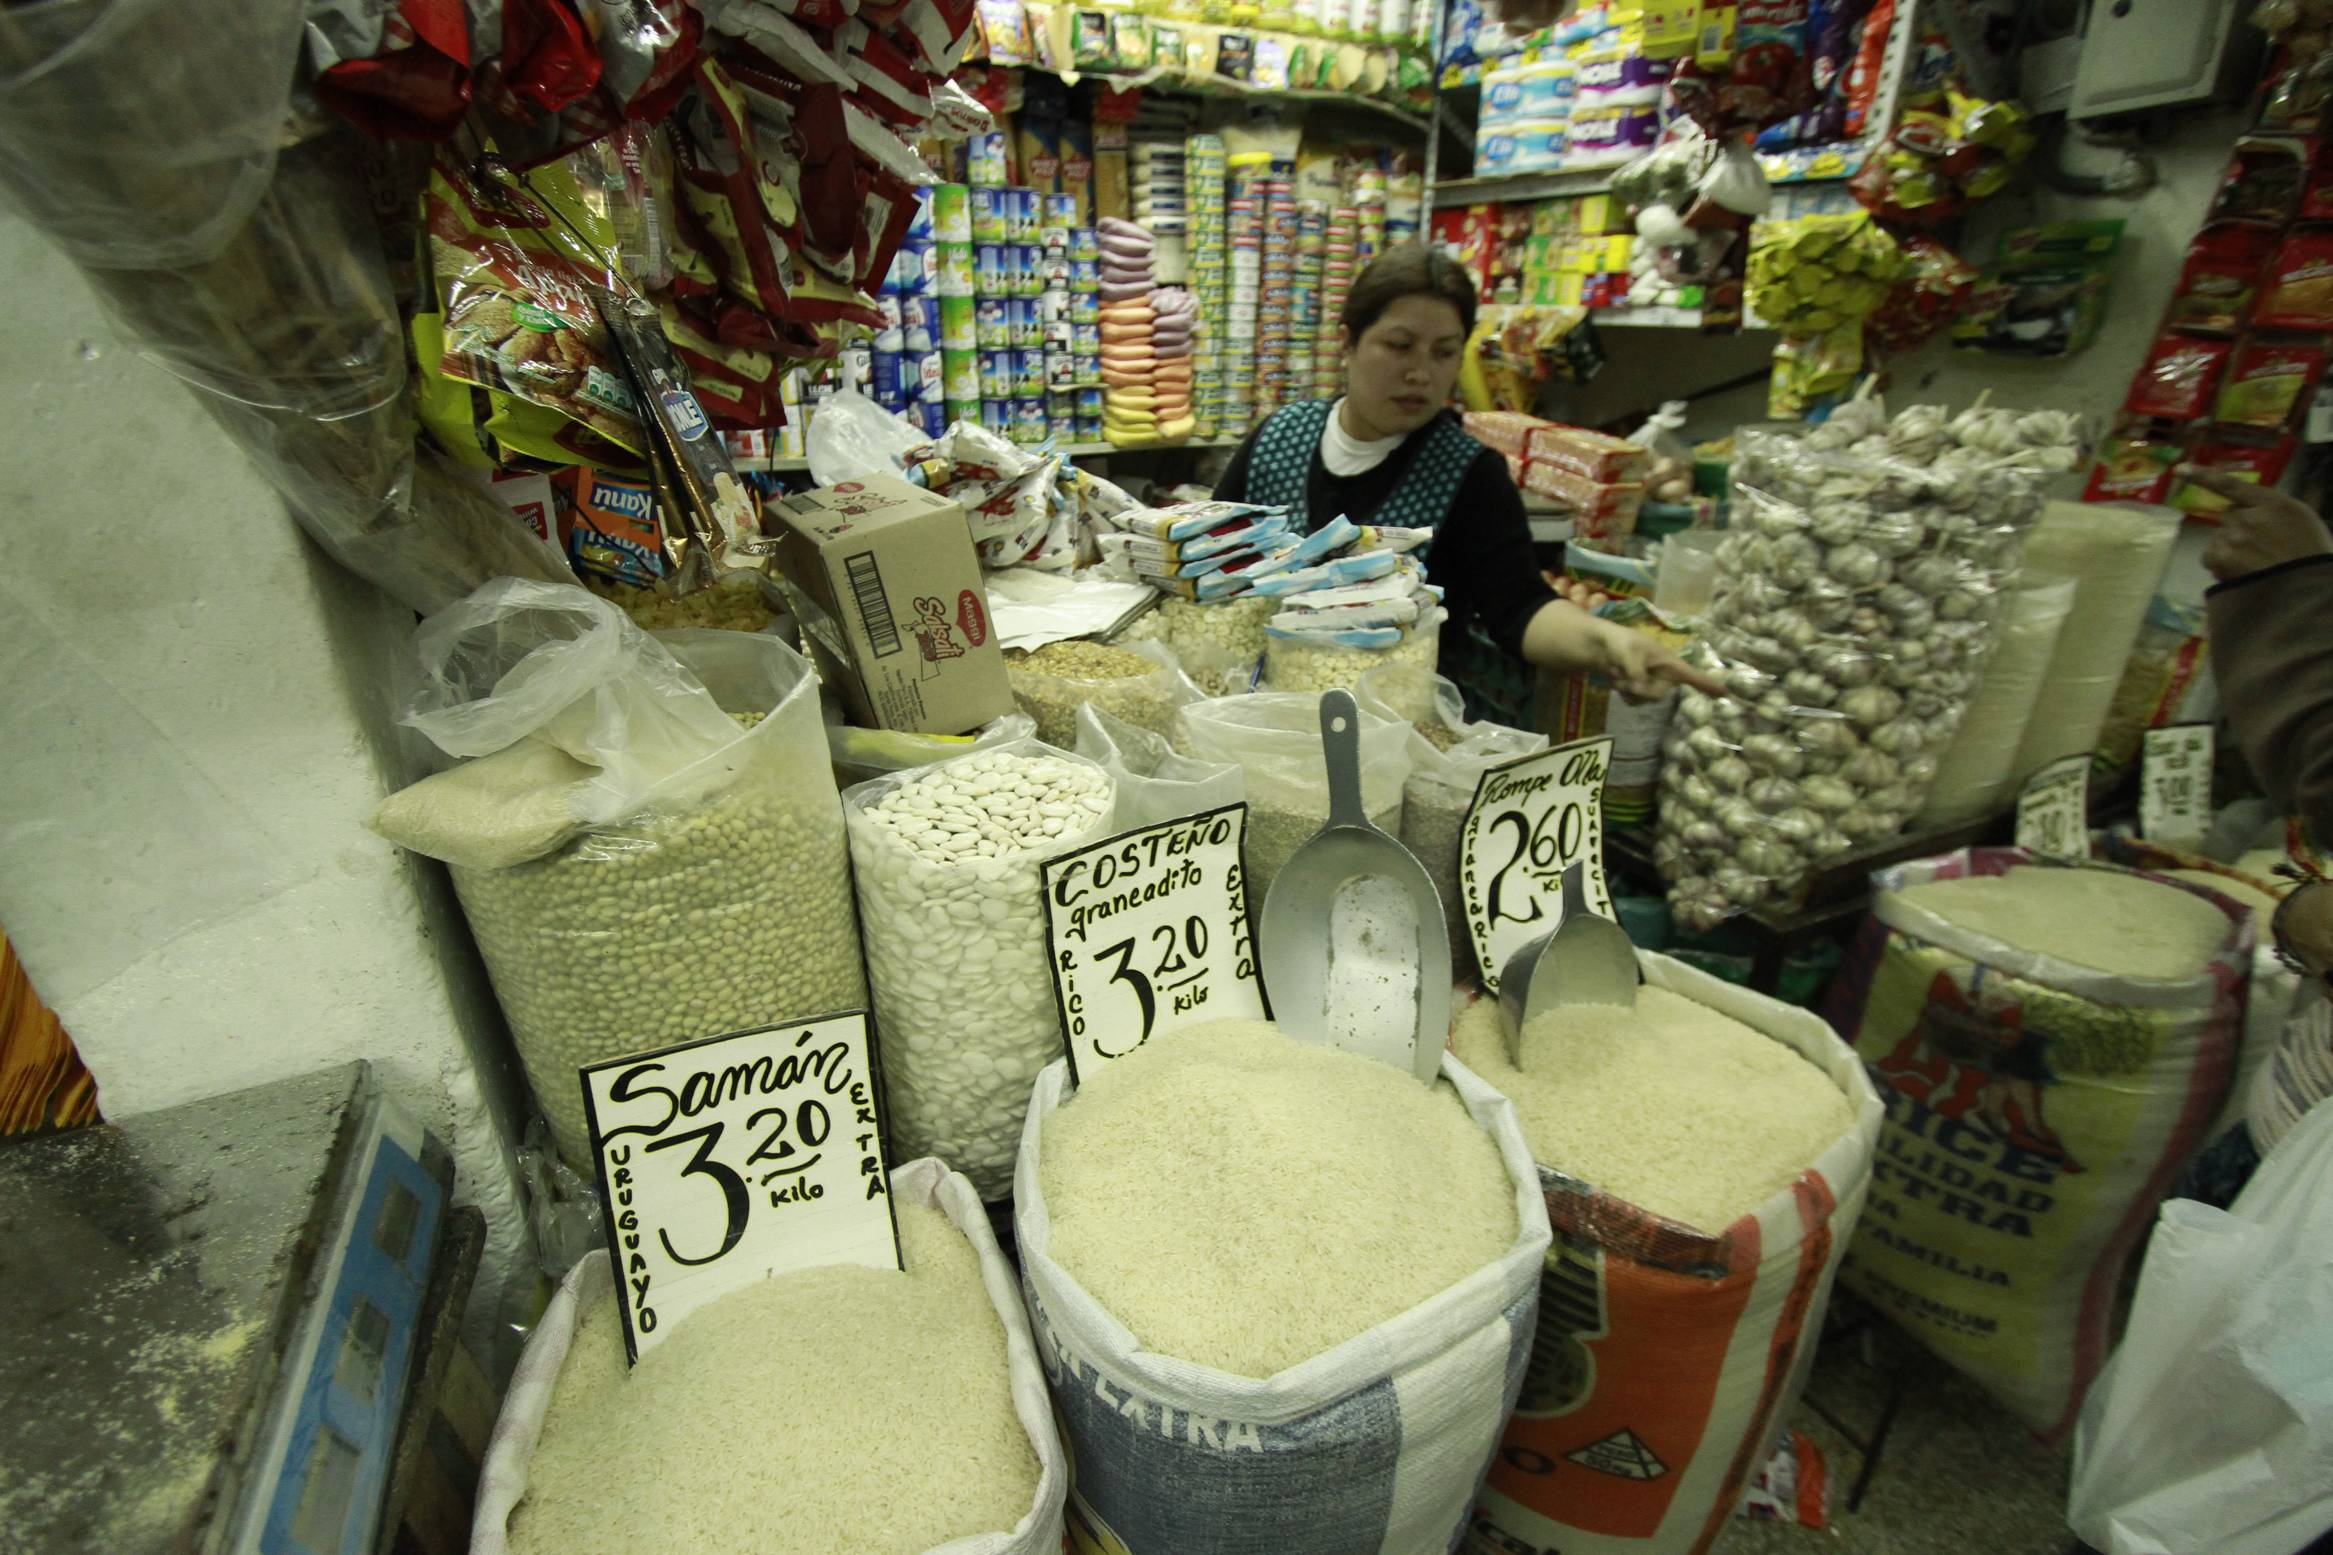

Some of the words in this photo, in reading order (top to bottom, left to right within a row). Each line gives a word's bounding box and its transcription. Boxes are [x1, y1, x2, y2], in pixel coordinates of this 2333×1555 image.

[593, 487, 653, 520] Kanú
[961, 596, 982, 641] Maggi
[1478, 772, 1553, 809] Rompe
[1559, 750, 1607, 787] Olla
[1055, 815, 1231, 907] COSTEÑO
[1064, 858, 1202, 942] graneadito
[601, 1030, 853, 1148] Samán
[850, 1082, 886, 1201] EXTRA
[609, 1145, 658, 1333] URUGUAYO
